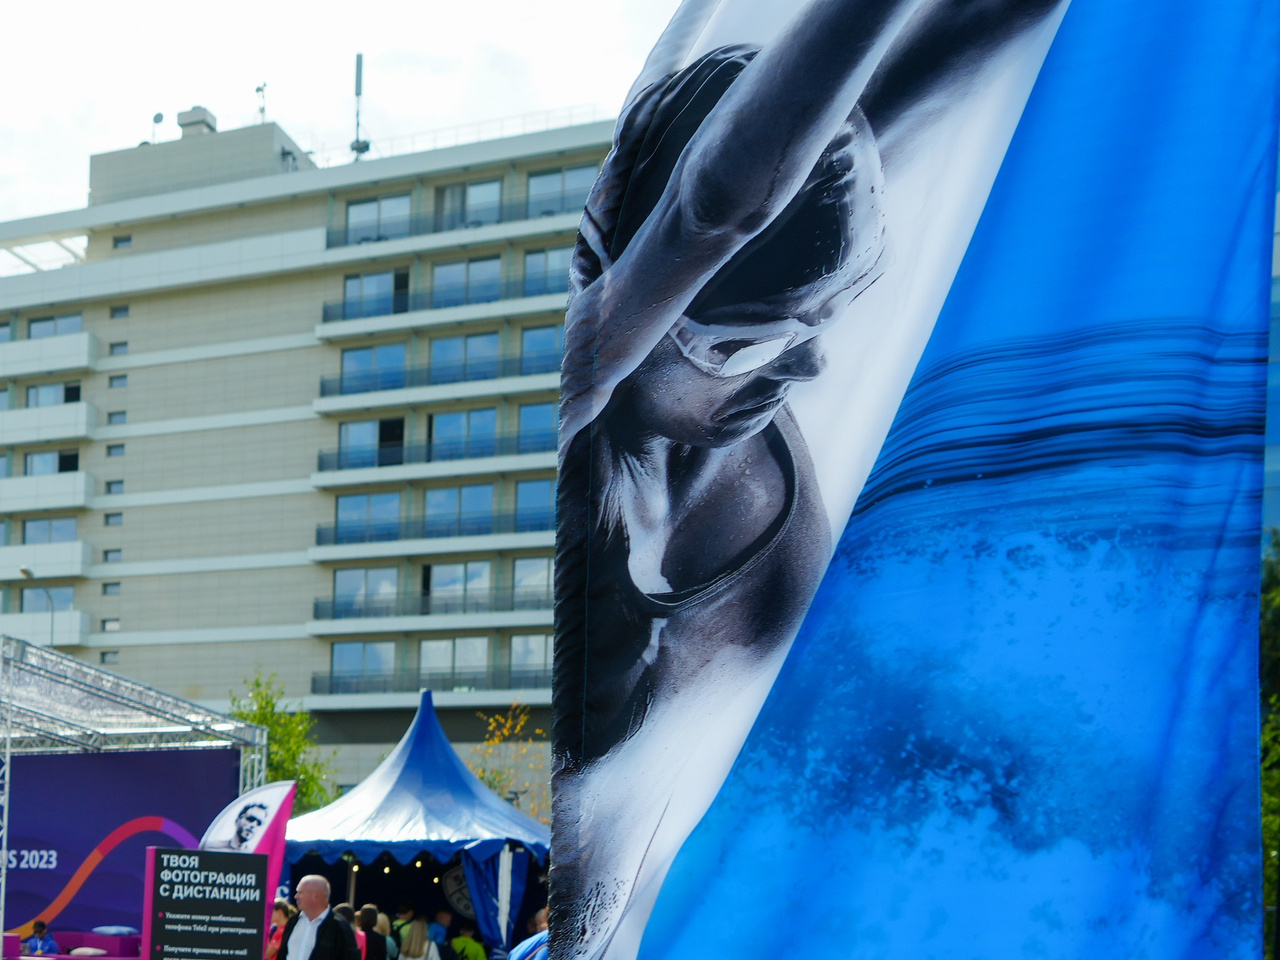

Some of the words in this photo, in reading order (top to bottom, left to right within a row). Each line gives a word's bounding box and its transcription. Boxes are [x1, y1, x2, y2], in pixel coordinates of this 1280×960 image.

[19, 850, 57, 869] 2023
[161, 854, 199, 868] ТВОЯ
[160, 869, 256, 886] ФОТОГРАФИЯ
[159, 884, 171, 897] С
[172, 885, 261, 902] ДИСТАНЦИИ
